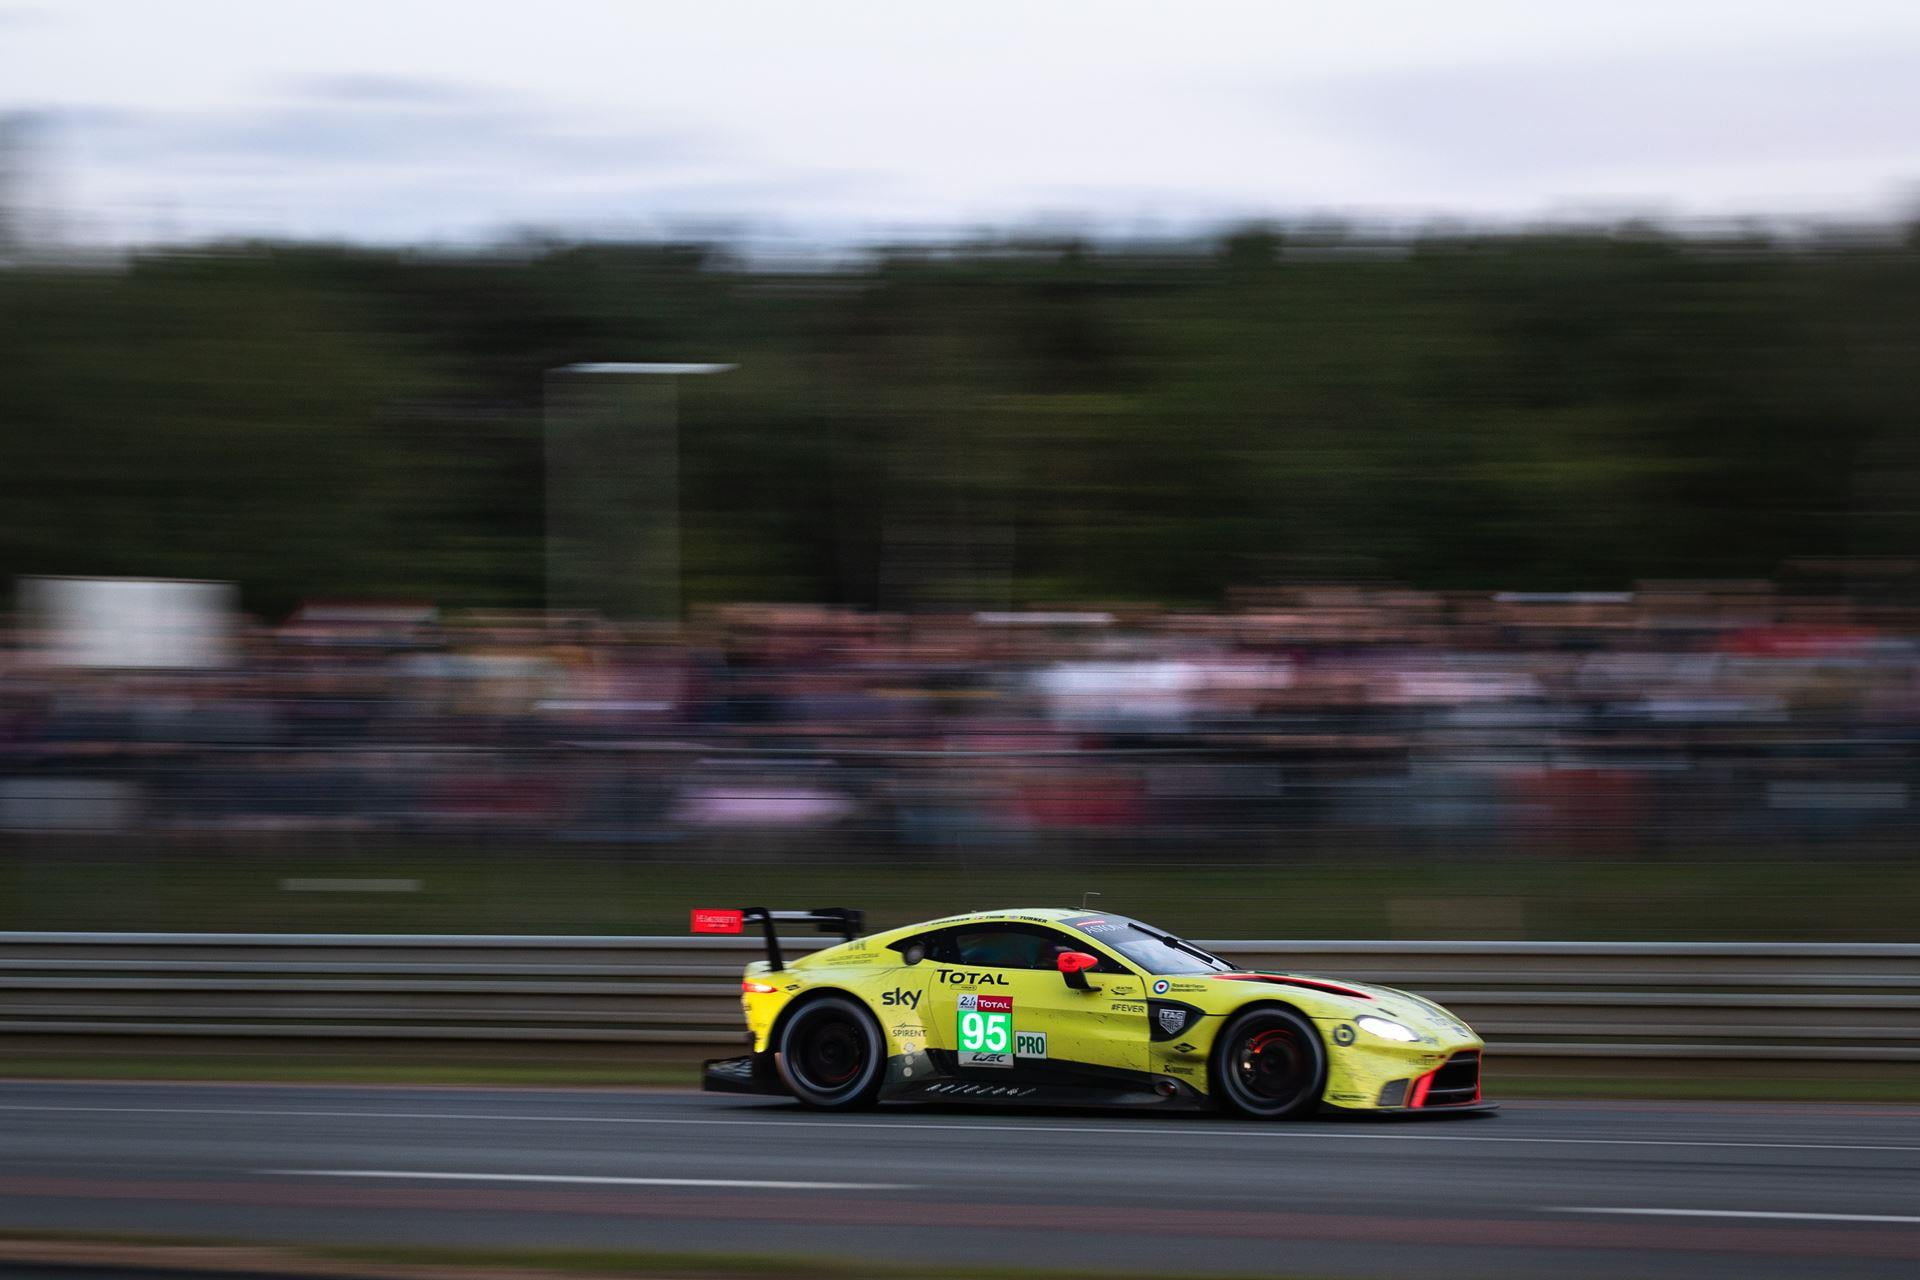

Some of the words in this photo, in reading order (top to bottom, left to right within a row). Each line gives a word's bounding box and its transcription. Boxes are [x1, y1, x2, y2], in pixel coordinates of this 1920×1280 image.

[936, 969, 1010, 985] TOTAL
[881, 987, 923, 1010] sky
[979, 1000, 1010, 1009] TOTAL
[1111, 1003, 1145, 1013] #FEVER
[1162, 1011, 1184, 1020] TAG
[892, 1029, 928, 1038] SPIRENT
[962, 1012, 1007, 1052] 95
[1017, 1035, 1045, 1055] PRO
[972, 1053, 1006, 1063] WEC
